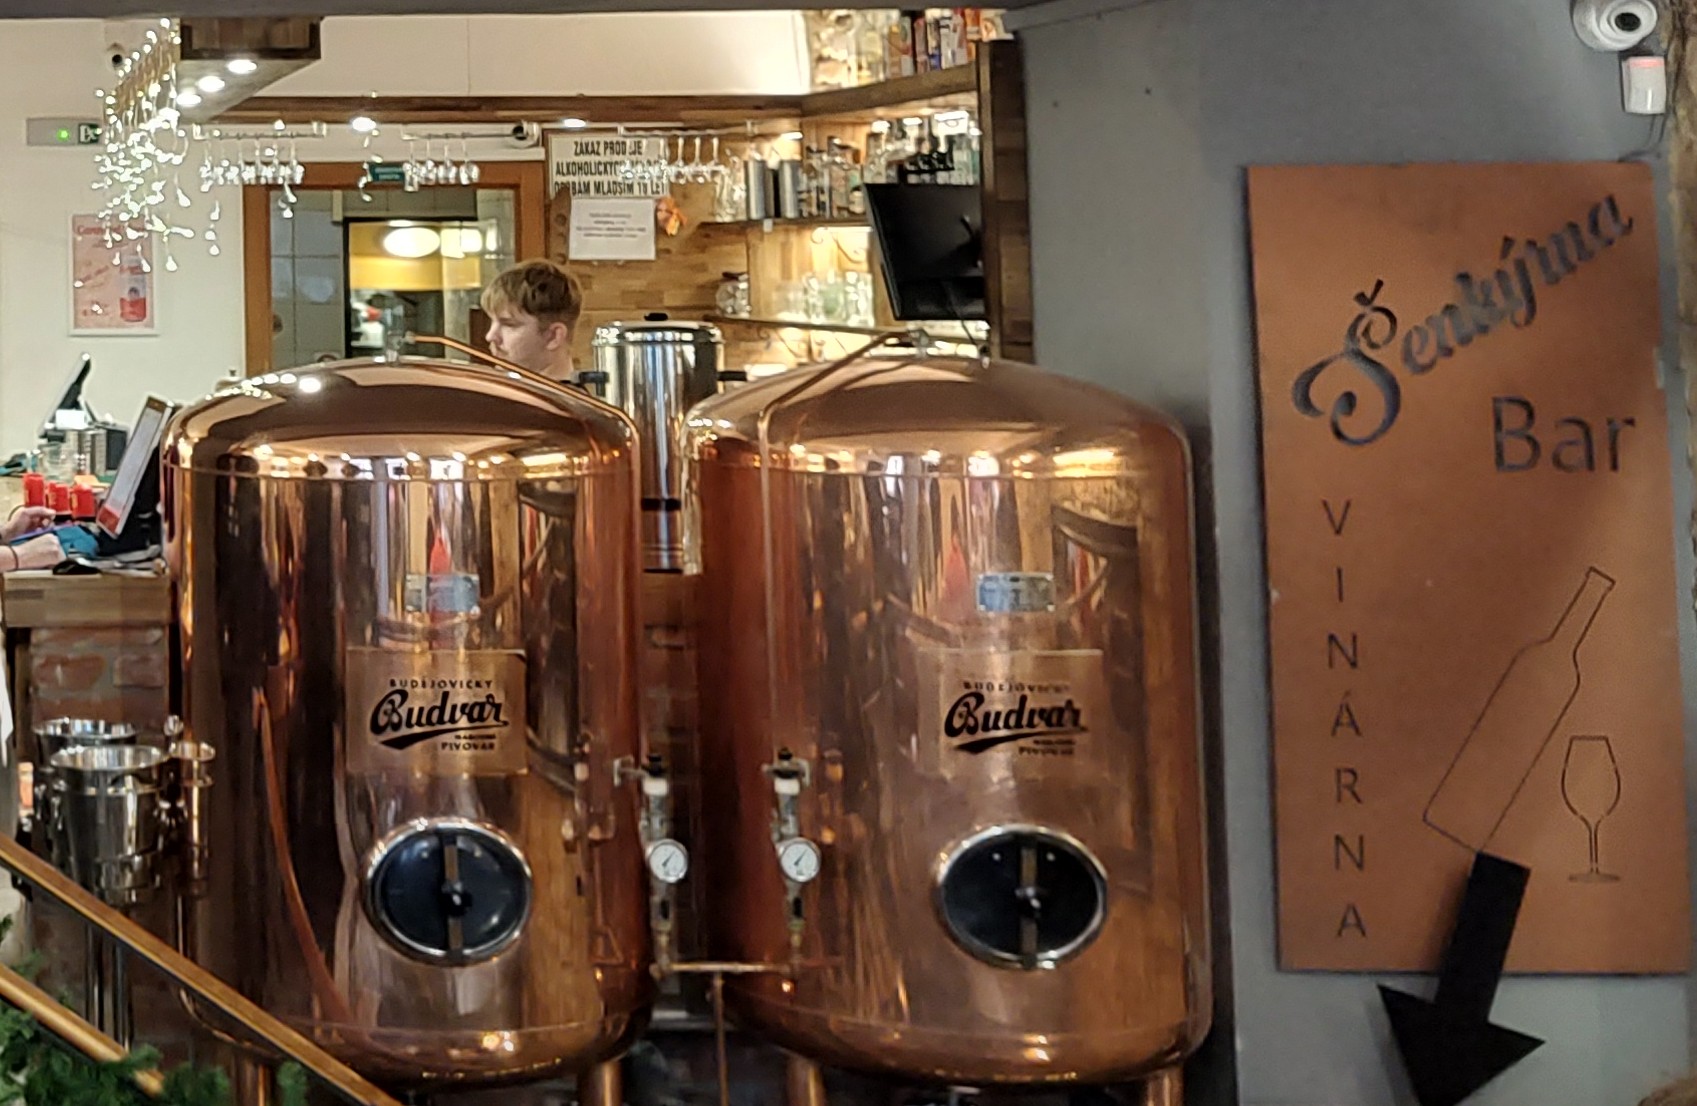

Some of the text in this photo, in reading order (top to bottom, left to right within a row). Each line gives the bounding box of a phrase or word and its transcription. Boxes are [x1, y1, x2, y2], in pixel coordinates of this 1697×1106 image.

[603, 140, 643, 156] PRODJE
[1492, 395, 1636, 473] Bar
[370, 688, 510, 736] Budvar
[944, 691, 1089, 738] Budvar
[1322, 500, 1367, 938] VINÁRNA
